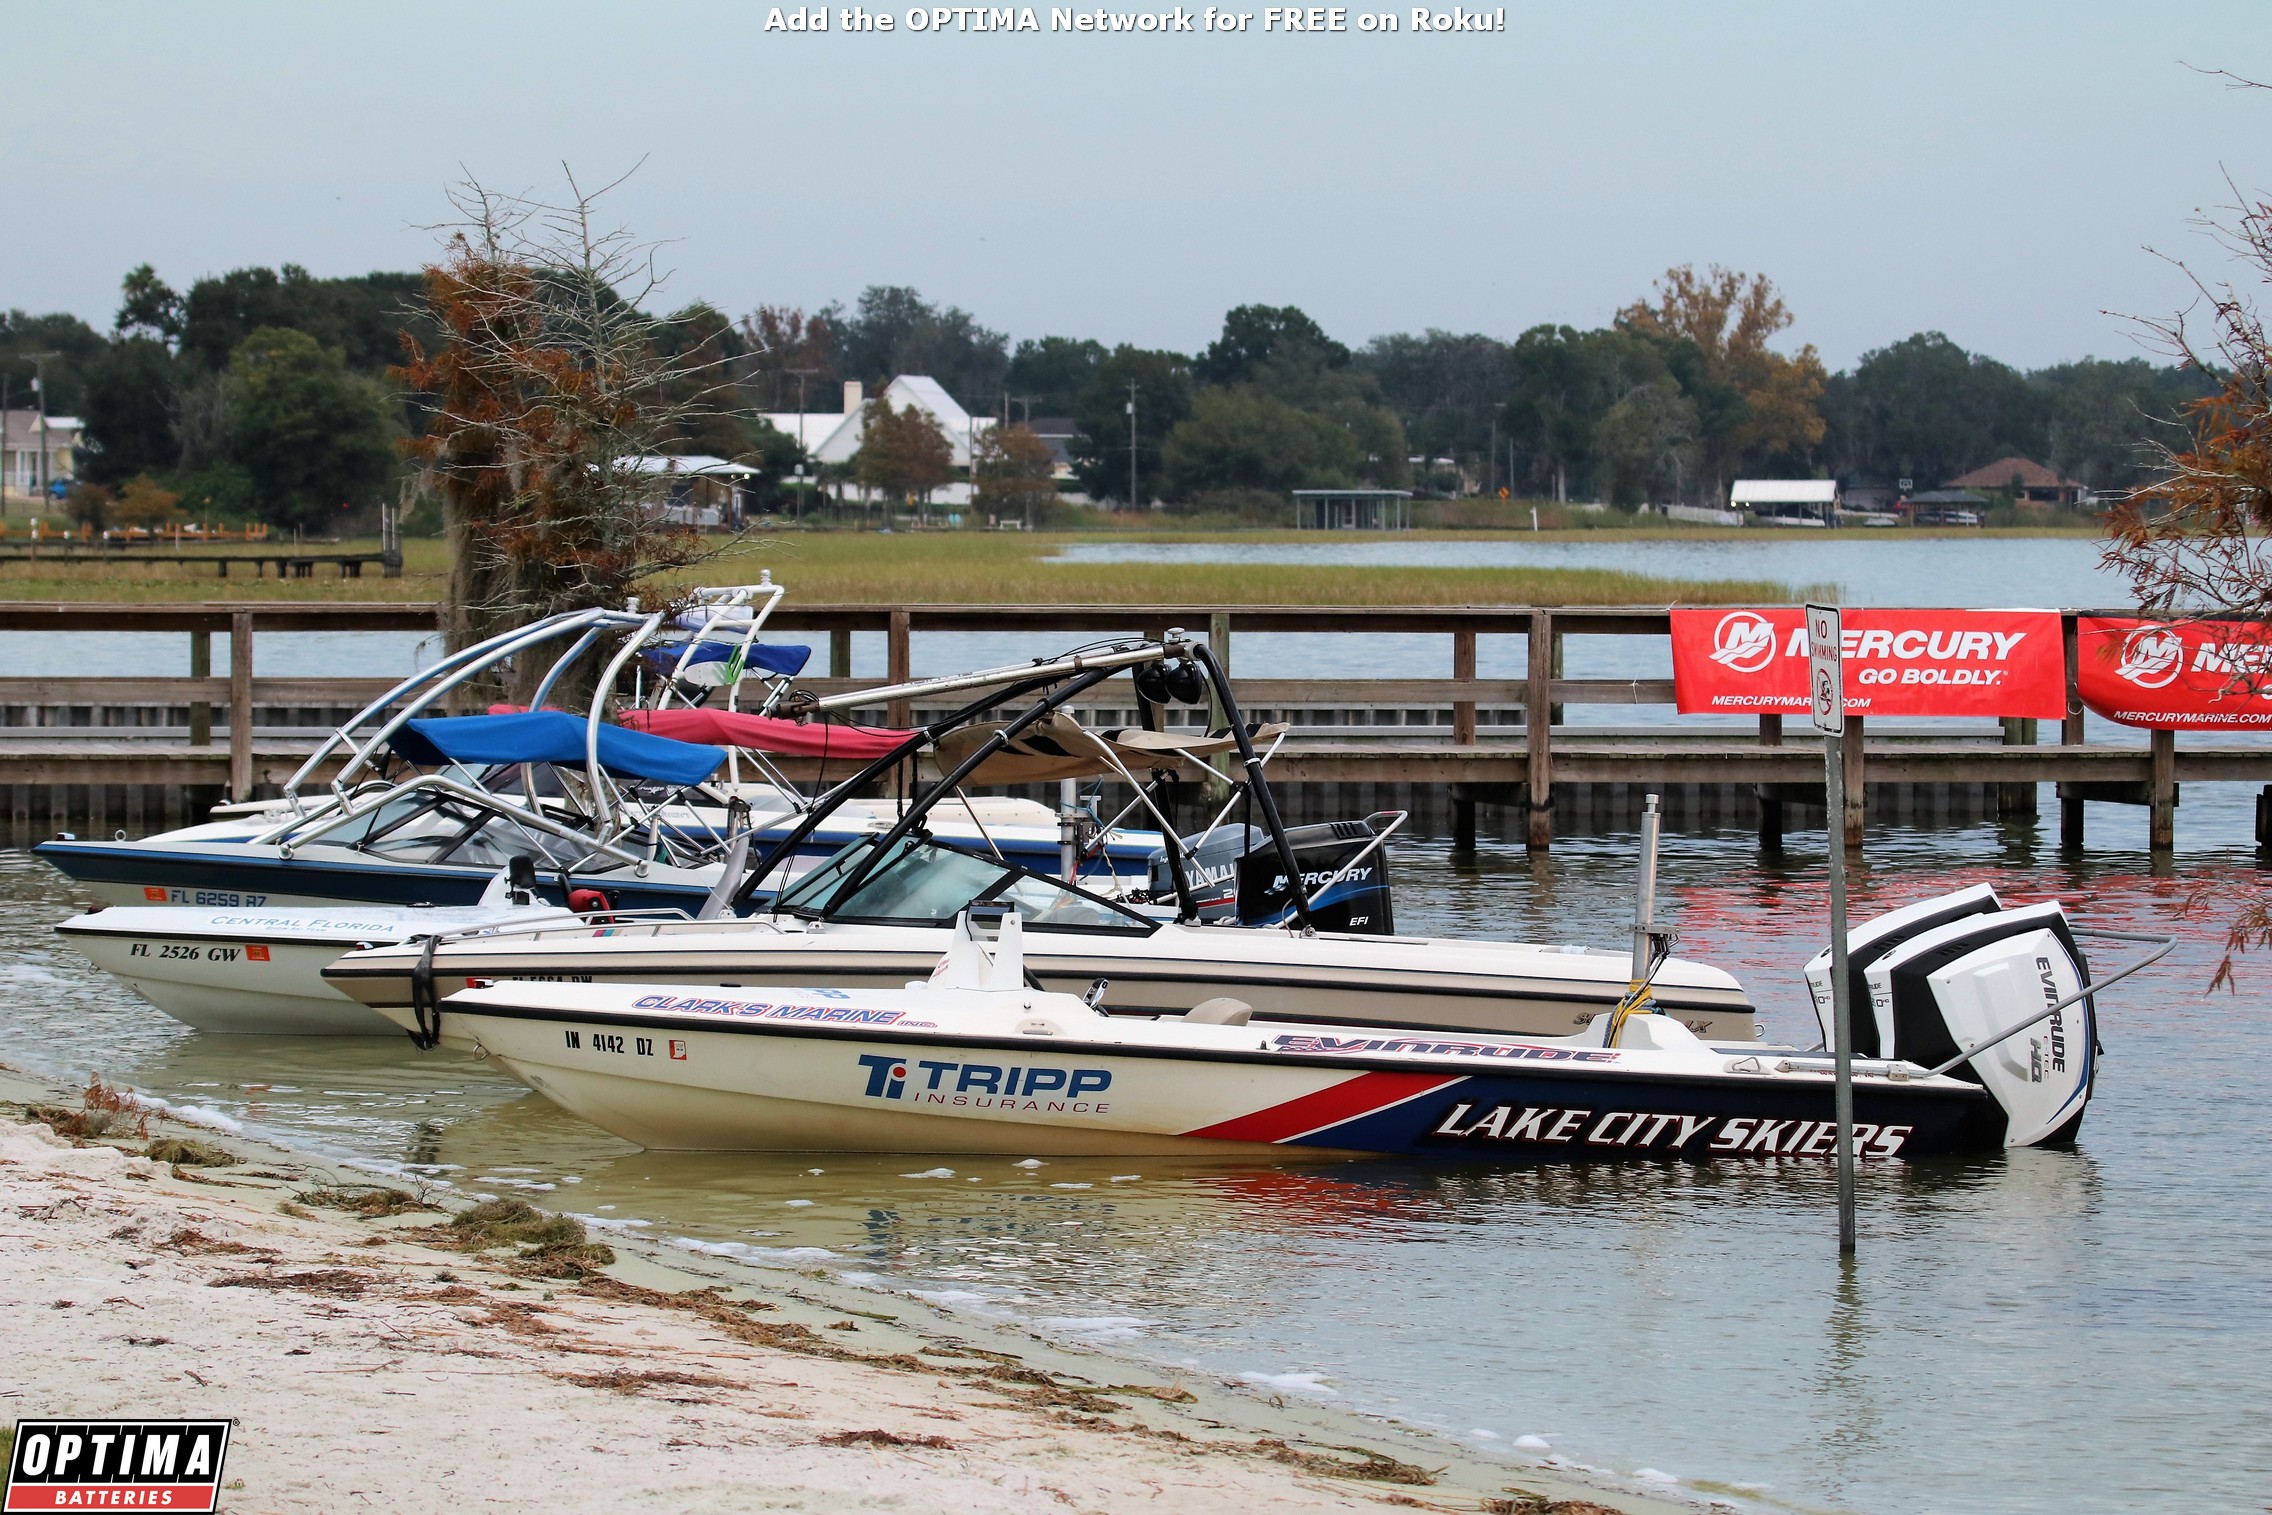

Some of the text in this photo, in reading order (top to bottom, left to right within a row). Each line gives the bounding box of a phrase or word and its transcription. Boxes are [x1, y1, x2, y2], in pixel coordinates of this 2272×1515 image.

[1815, 619, 1828, 639] NO
[1858, 669, 1898, 685] GO
[1711, 695, 1872, 709] MERCURYMARCOM
[2114, 710, 2272, 724] MERCURYMARINE.COM
[1185, 863, 1235, 888] YAMA
[171, 890, 189, 904] FL
[195, 891, 240, 907] 6259
[210, 916, 395, 932] CENTRAL FLORIDA
[1349, 916, 1369, 927] EFI
[130, 943, 151, 957] FL
[159, 945, 200, 960] 2526
[207, 947, 241, 962] GW
[631, 994, 772, 1017] CLARK'S
[767, 1004, 907, 1025] MARINE
[565, 1030, 580, 1048] IN
[593, 1033, 624, 1053] 4142
[636, 1037, 654, 1056] DZ
[1271, 1034, 1622, 1063] EVINRUDE
[918, 1060, 1112, 1098] TRIPP
[914, 1092, 1110, 1113] INSURANCE
[1434, 1103, 1914, 1157] LAKE CITY SKIERS
